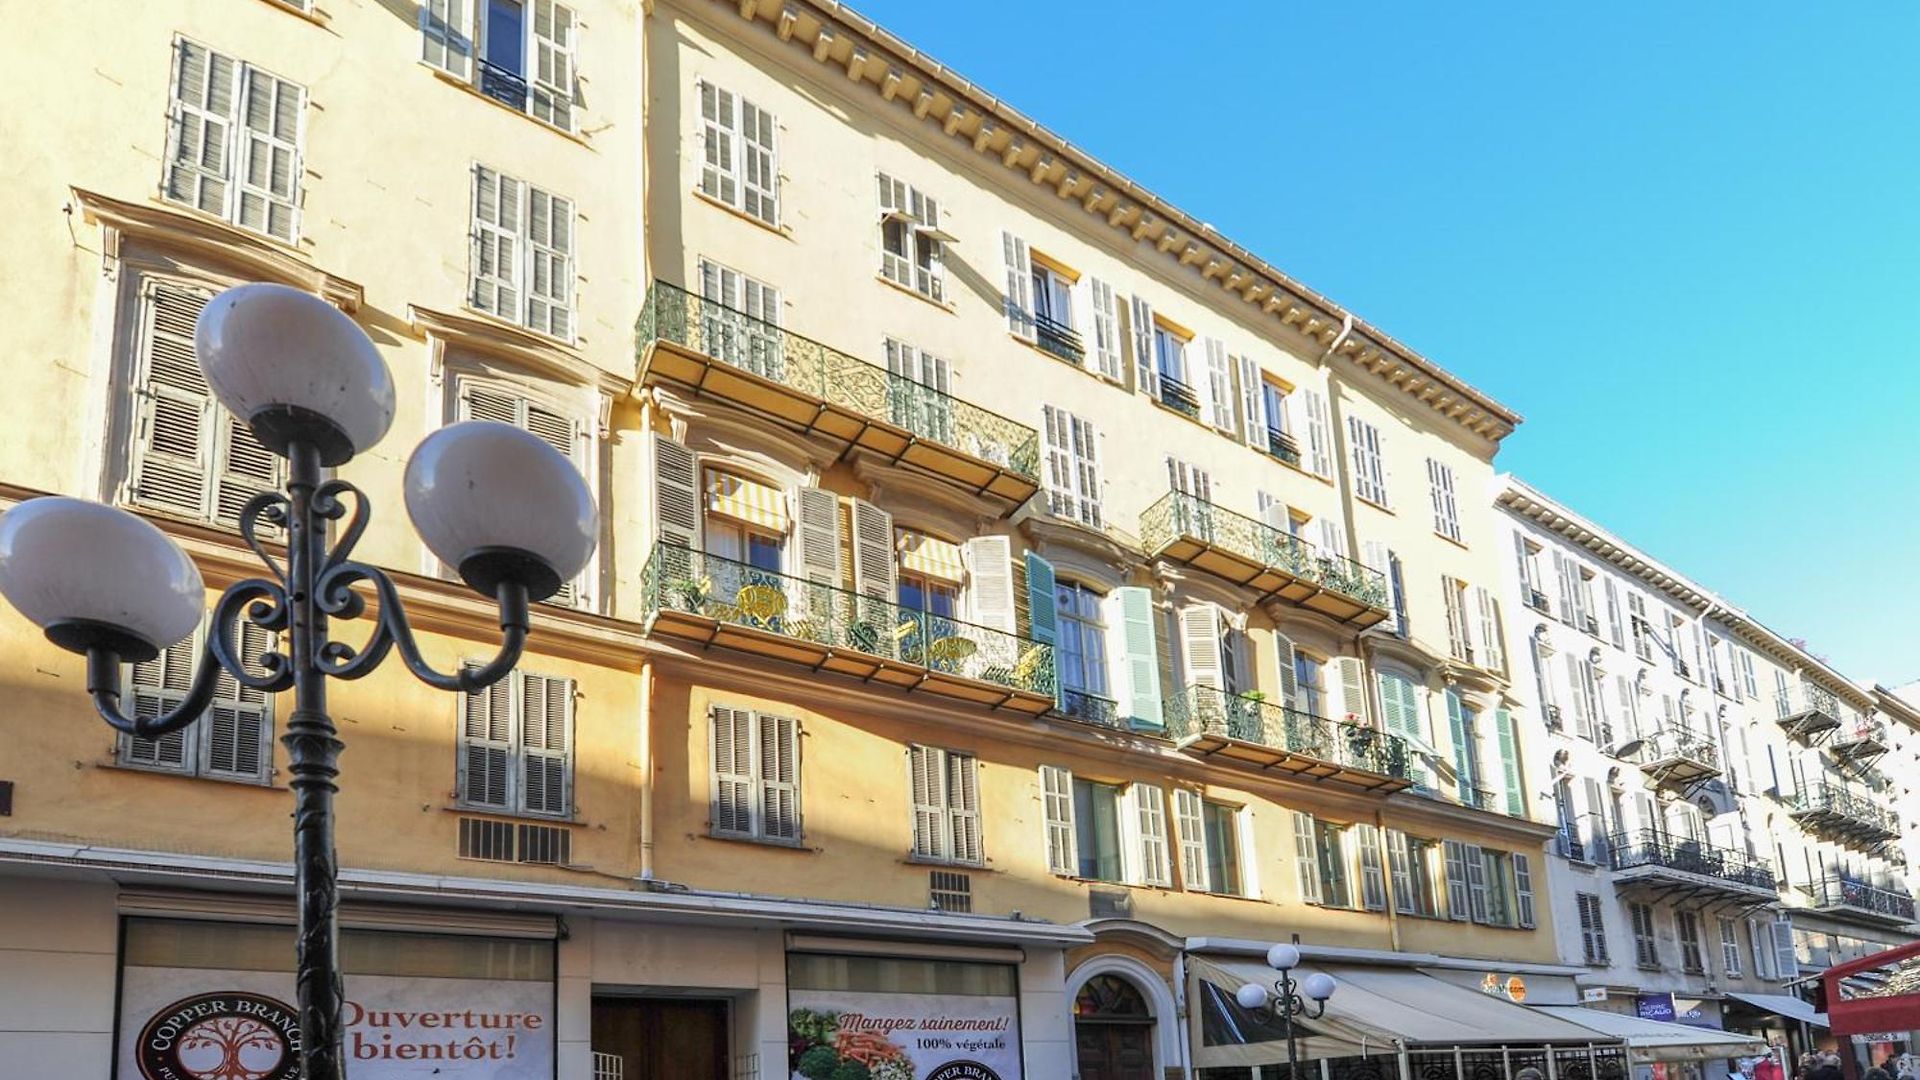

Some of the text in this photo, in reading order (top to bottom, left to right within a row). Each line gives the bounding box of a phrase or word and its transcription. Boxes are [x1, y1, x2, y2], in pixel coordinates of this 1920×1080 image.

[152, 1000, 226, 1051] COPPER
[839, 1013, 1009, 1035] Mangez sainement!
[351, 1032, 515, 1060] bientôt!
[917, 1038, 1006, 1052] 100% végétale
